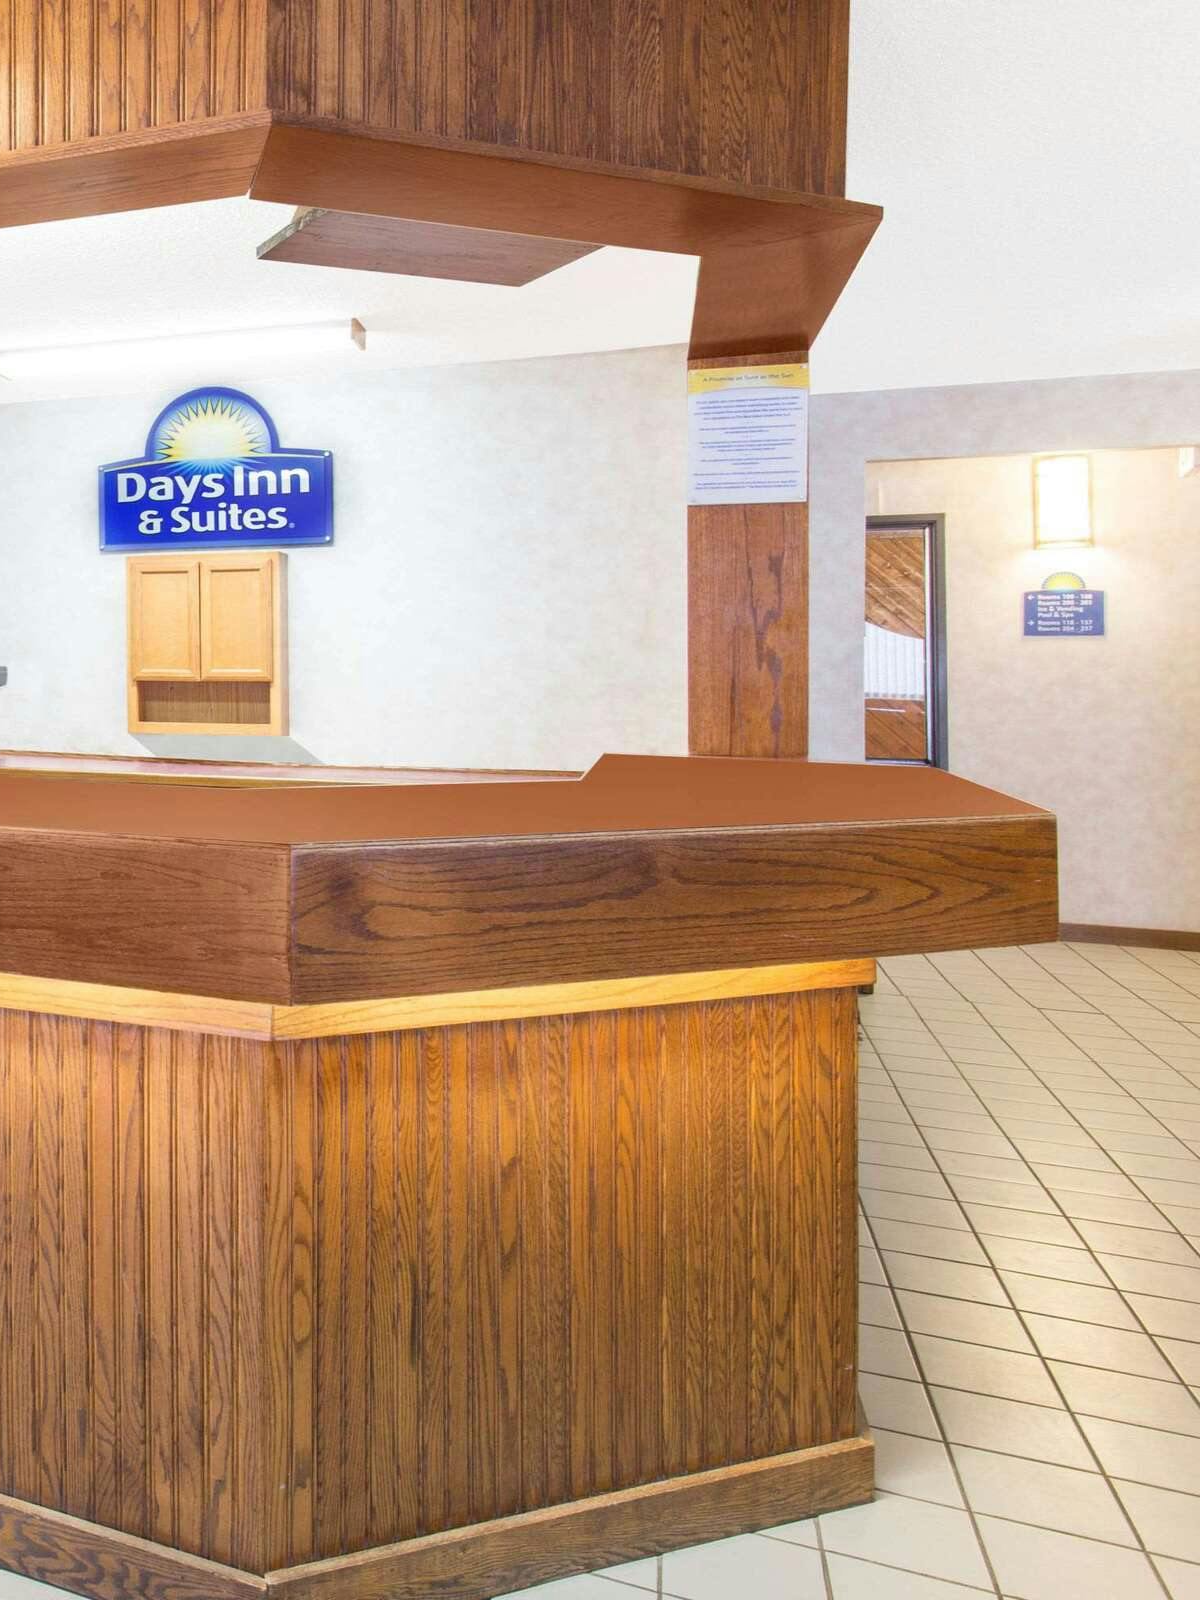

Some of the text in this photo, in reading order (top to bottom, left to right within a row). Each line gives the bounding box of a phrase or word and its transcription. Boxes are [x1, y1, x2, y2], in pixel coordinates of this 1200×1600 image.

[116, 465, 311, 505] Days Inn
[137, 502, 289, 535] & Suites
